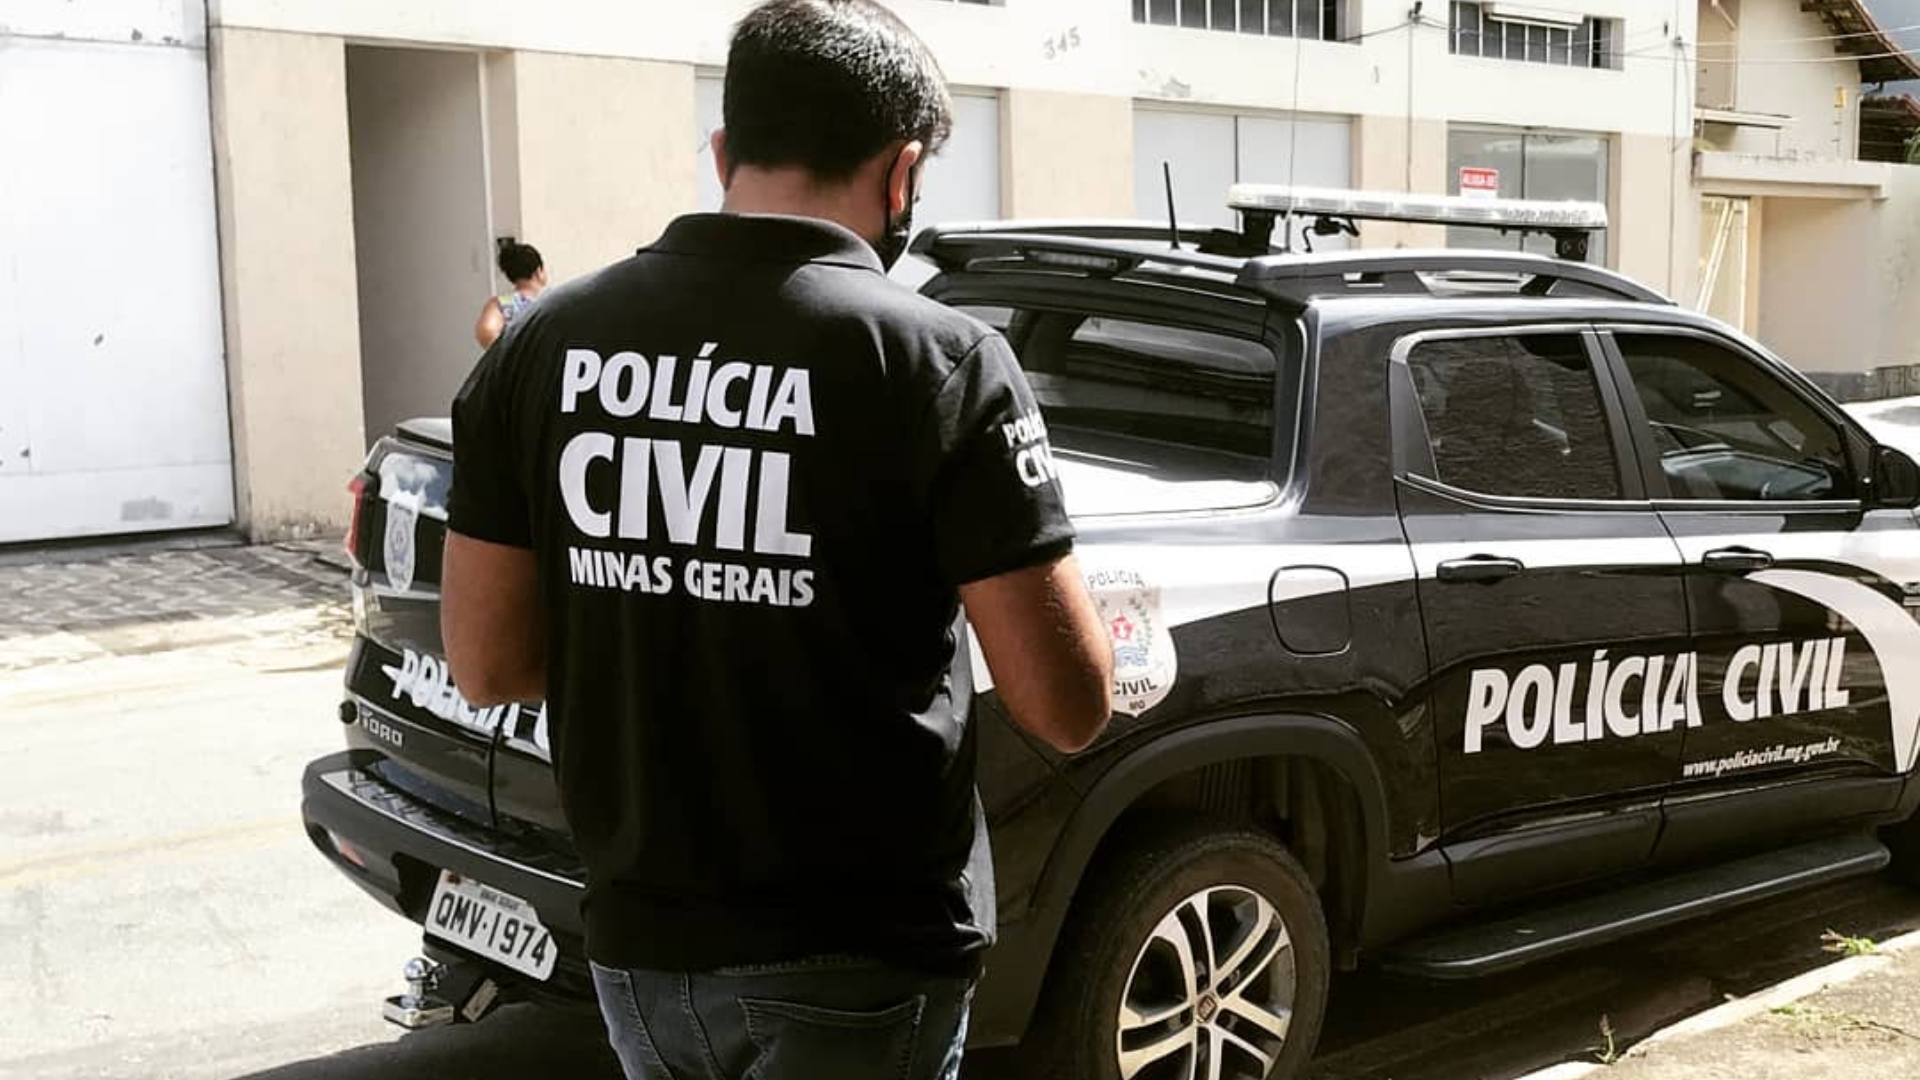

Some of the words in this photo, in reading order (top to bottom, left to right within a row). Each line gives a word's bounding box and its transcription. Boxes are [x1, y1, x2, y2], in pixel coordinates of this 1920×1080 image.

[1043, 26, 1081, 60] 345
[561, 342, 815, 437] POLÍCIA
[559, 431, 812, 557] CIVIL
[569, 546, 672, 594] MINAS
[684, 558, 815, 607] GERAIS
[362, 710, 403, 747] TORO
[1464, 648, 1702, 754] POLÍCIA
[1723, 637, 1850, 722] CIVIL
